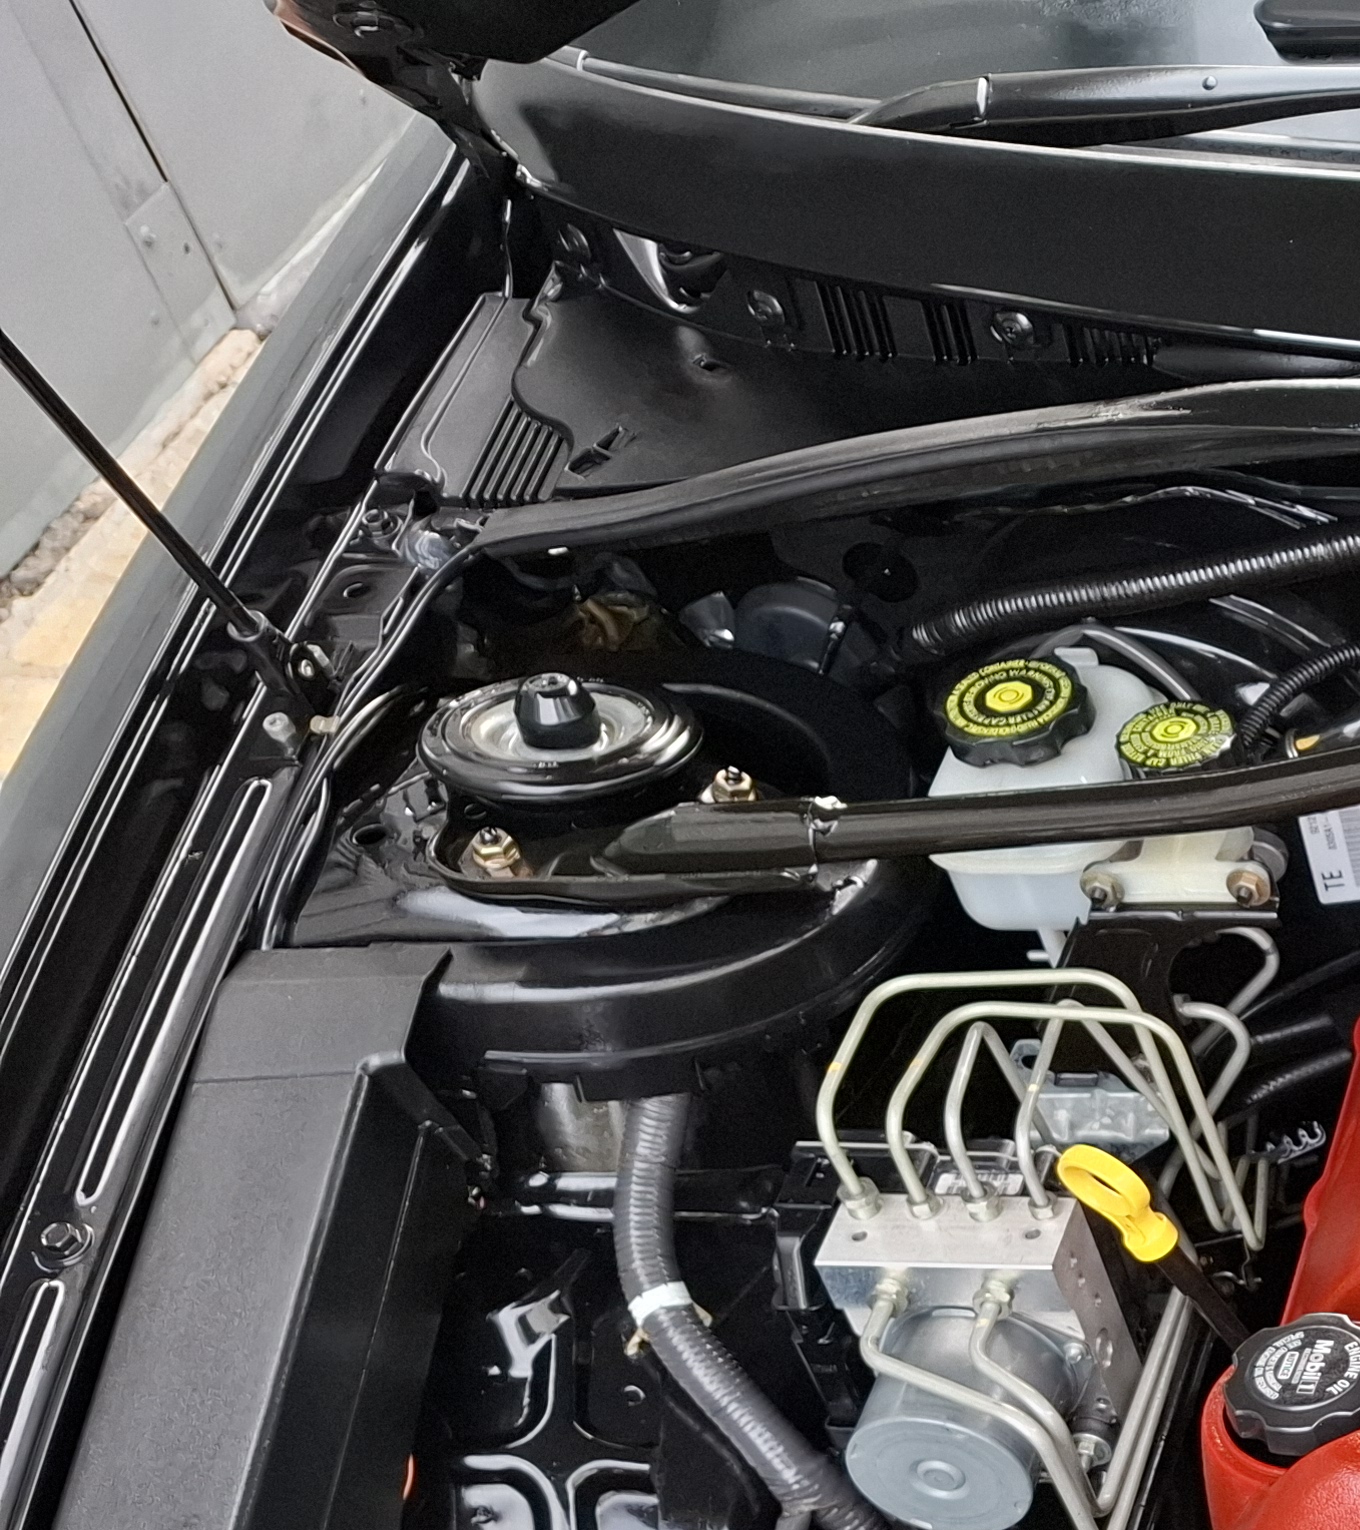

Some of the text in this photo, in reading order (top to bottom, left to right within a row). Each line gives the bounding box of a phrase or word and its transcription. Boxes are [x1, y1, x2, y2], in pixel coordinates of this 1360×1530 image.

[1320, 868, 1345, 892] TE
[1300, 1339, 1334, 1379] Mobil
[1325, 1379, 1350, 1395] OIL
